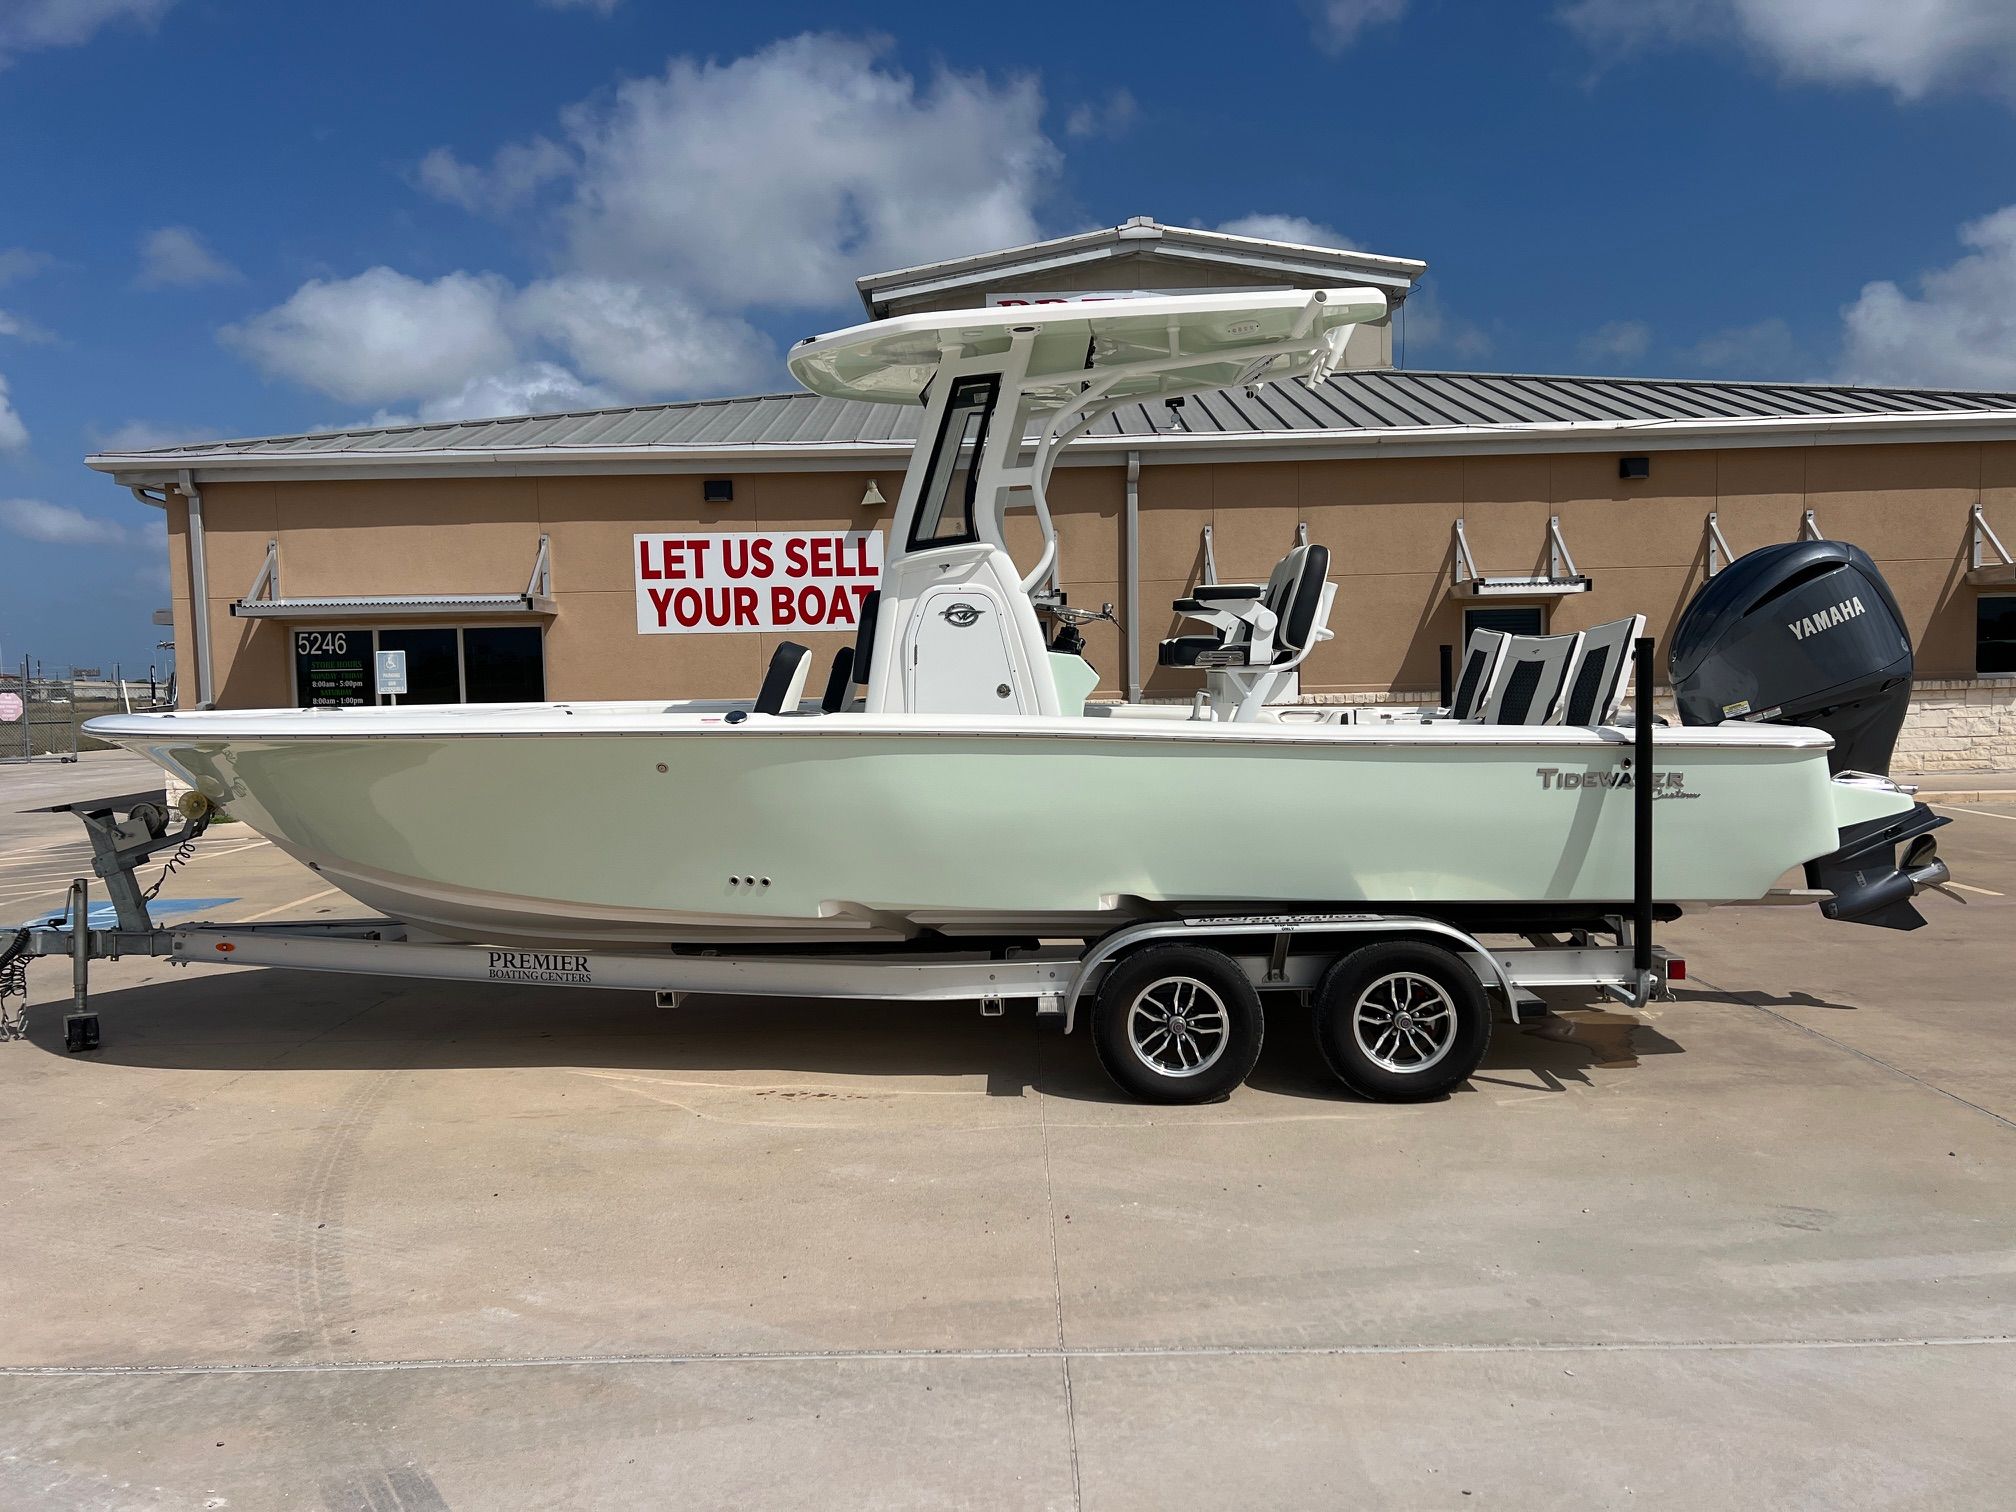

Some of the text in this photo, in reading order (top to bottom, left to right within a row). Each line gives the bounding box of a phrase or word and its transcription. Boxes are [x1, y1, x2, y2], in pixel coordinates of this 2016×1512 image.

[640, 537, 879, 580] LET US SELL
[647, 585, 875, 628] YOUR BOAT
[1788, 597, 1866, 641] YAMAHA
[298, 632, 347, 655] 5246
[311, 660, 362, 669] STORE HOURS
[312, 680, 335, 688] 8:00am
[339, 680, 363, 688] 5:00pm
[320, 688, 353, 696] SATURDAY
[312, 697, 336, 705] 8:00am
[340, 697, 364, 705] 1:00pm
[1536, 767, 1685, 790] TIDEWAER
[488, 951, 591, 973] PREMIER
[489, 968, 592, 983] BOATING CENTERS
